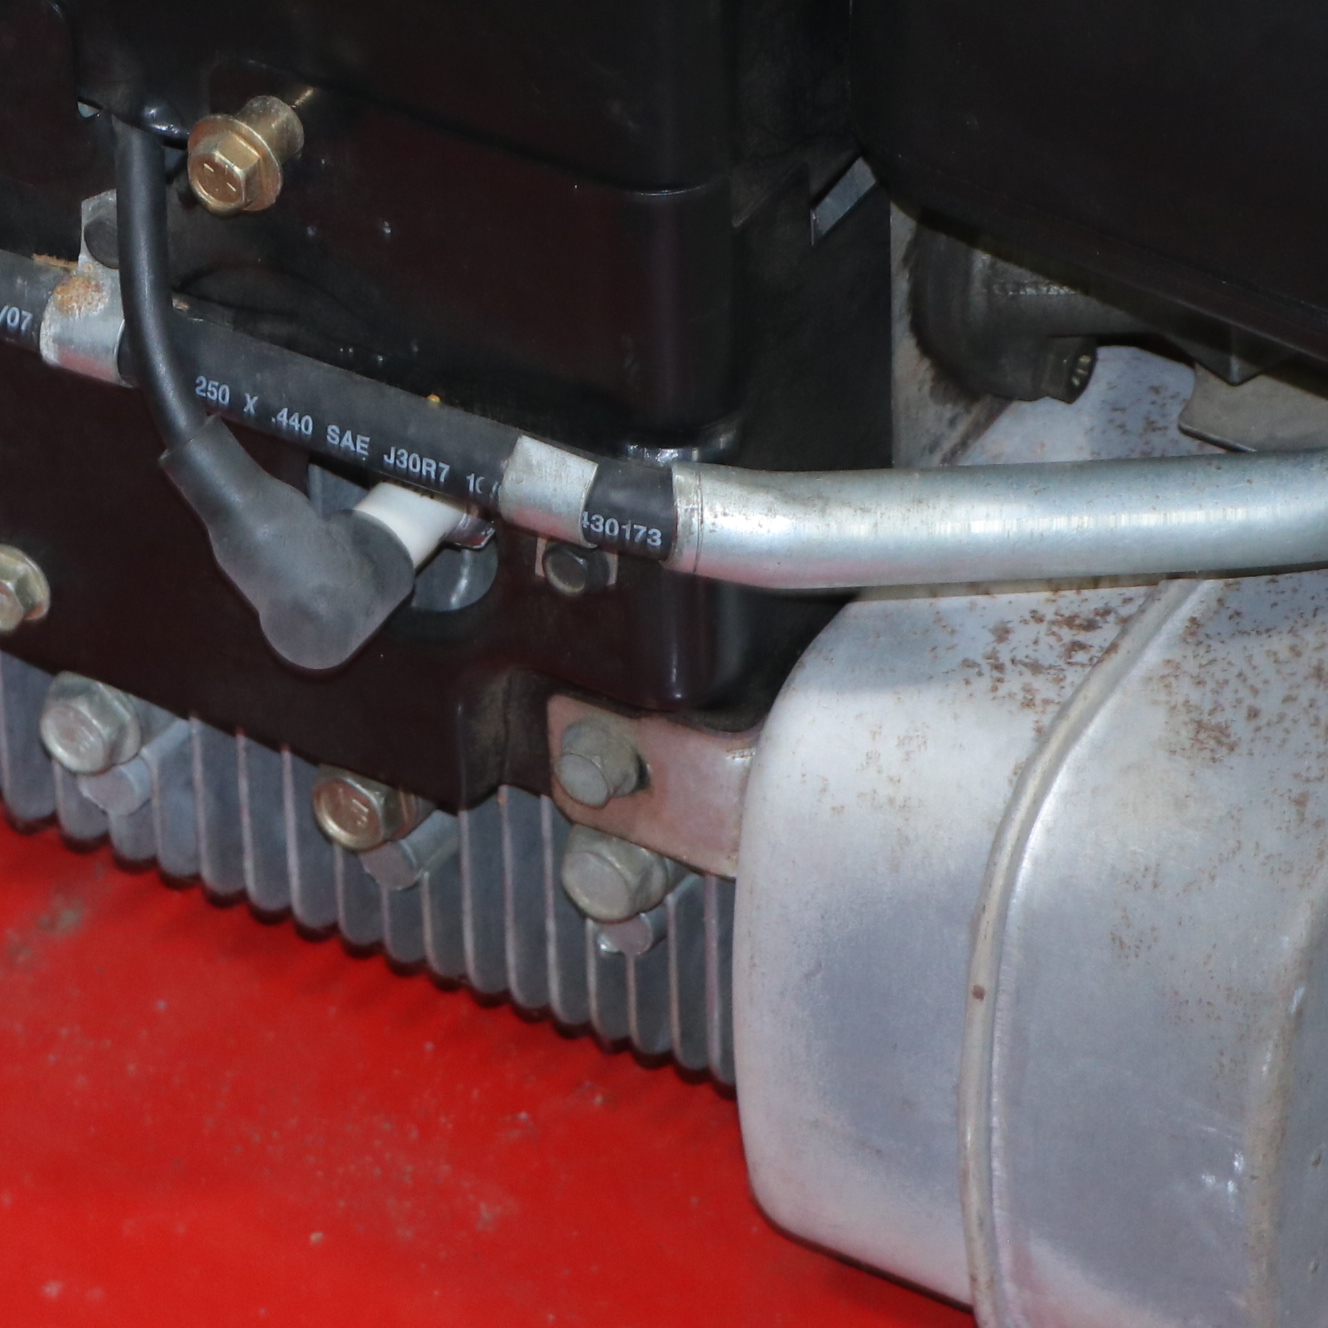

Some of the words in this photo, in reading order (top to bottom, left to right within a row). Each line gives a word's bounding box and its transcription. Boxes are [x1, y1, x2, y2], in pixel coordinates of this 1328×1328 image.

[195, 375, 230, 406] 250
[243, 392, 259, 416] X
[271, 407, 313, 437] .440
[326, 424, 371, 457] SAE
[382, 446, 451, 484] J30R7
